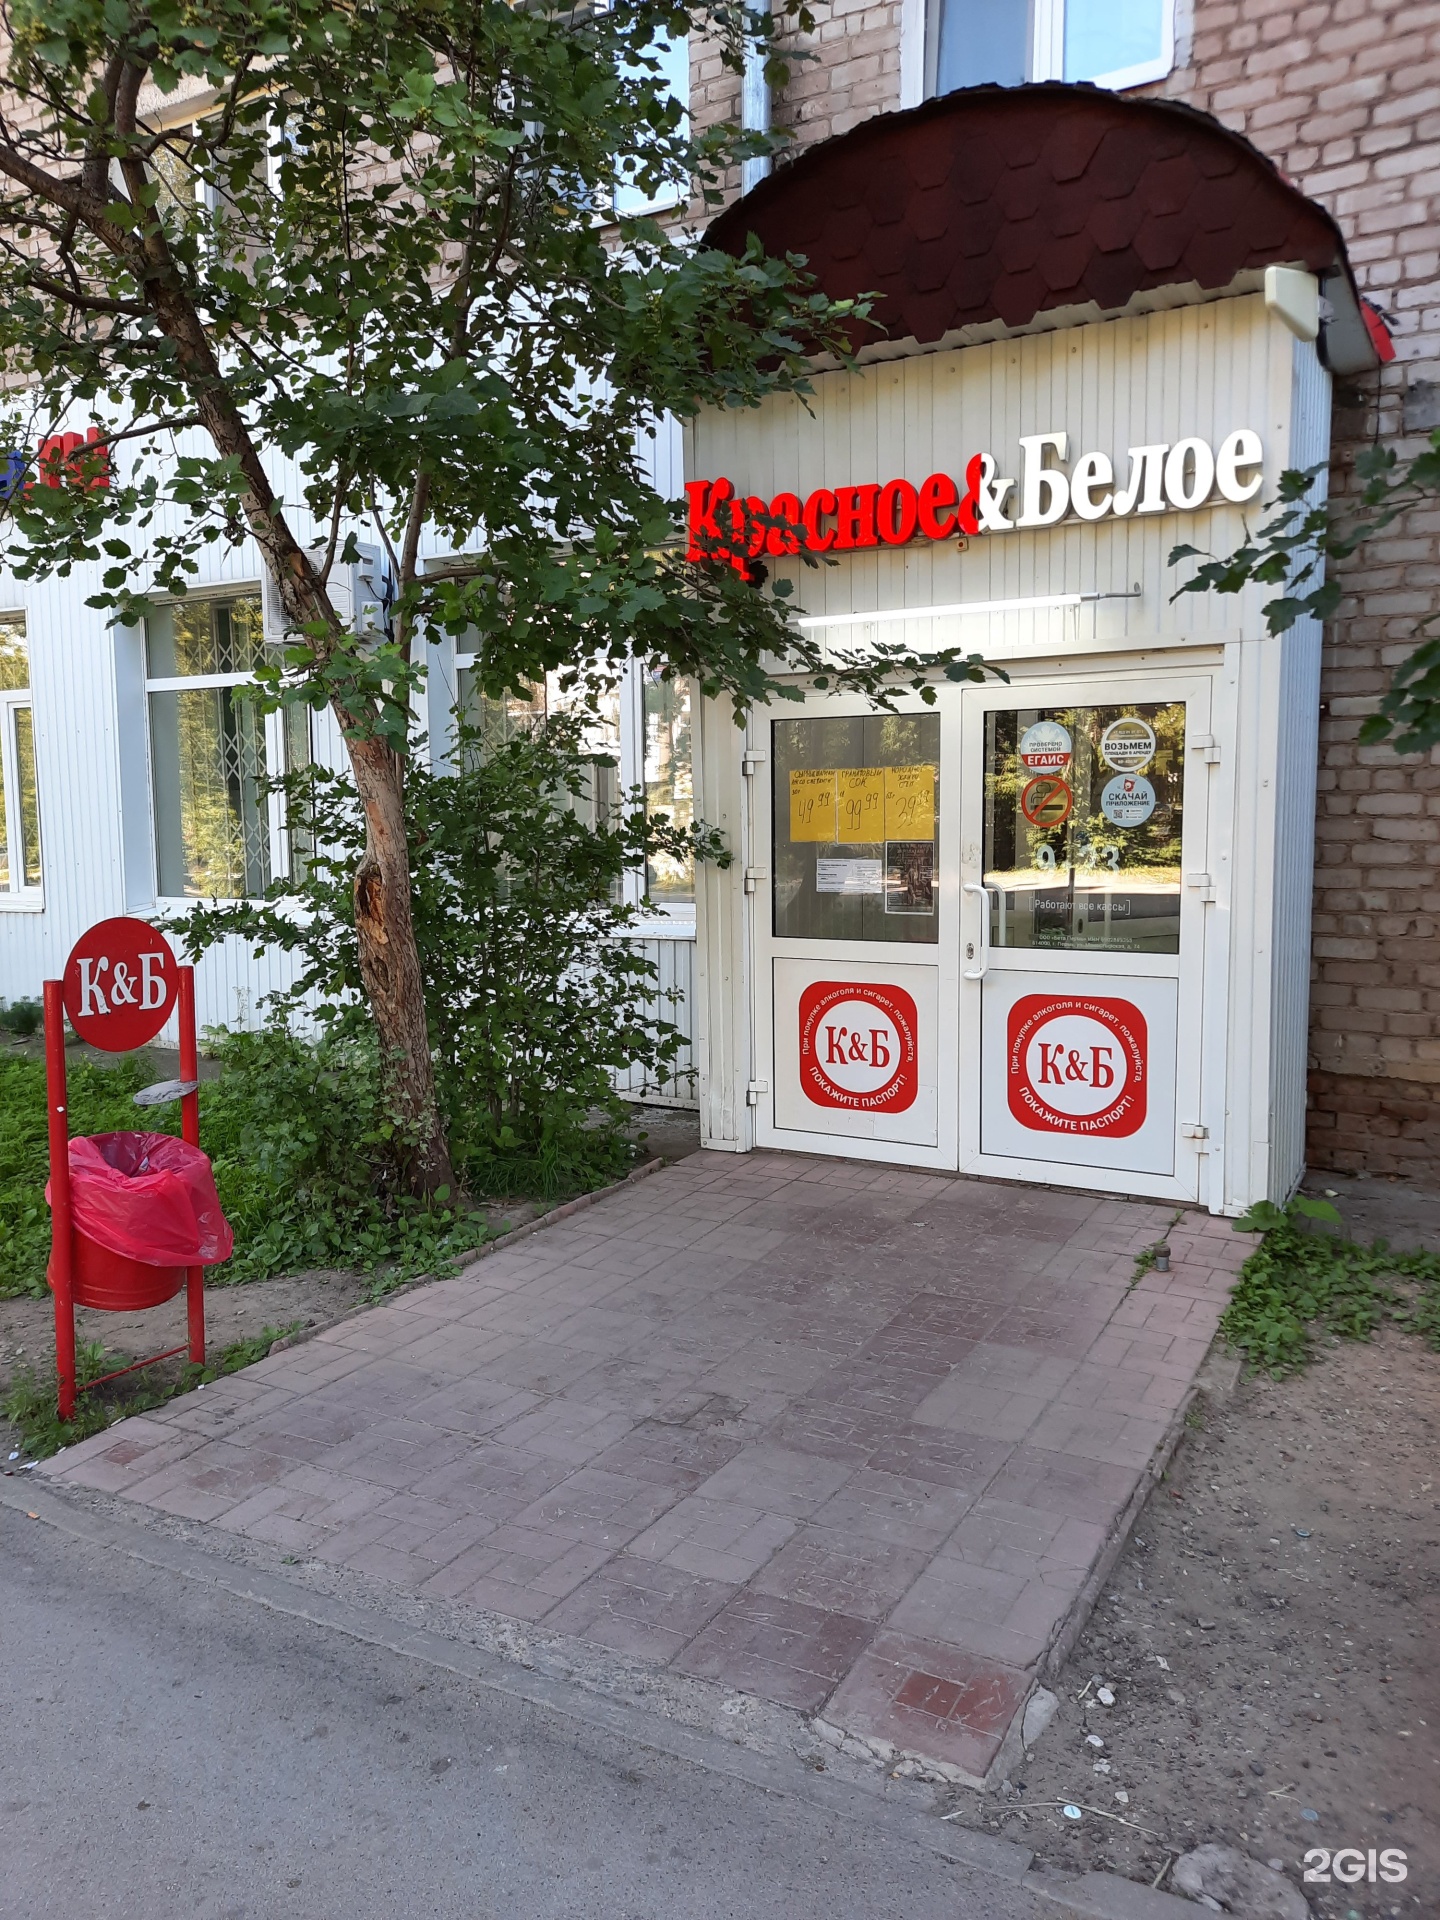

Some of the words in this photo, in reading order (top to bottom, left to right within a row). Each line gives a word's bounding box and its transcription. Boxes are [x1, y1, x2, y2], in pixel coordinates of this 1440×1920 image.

[1028, 754, 1064, 765] ЕГАИС
[1104, 742, 1152, 750] ВОЗЬМЕМ
[848, 778, 868, 788] СОК
[1108, 791, 1148, 800] СКАЧАЙ
[798, 798, 814, 824] 49
[818, 792, 830, 808] 99
[846, 799, 861, 830] 99
[864, 792, 879, 810] 99
[896, 796, 916, 829] 39
[1078, 902, 1094, 910] все
[77, 952, 167, 1017] К&Б
[804, 1004, 821, 1036] покупке
[820, 987, 854, 1006] алкоголя
[863, 989, 894, 1011] сигарет,
[894, 1009, 914, 1063] пожалуйста,
[1034, 1001, 1073, 1020] алкоголя
[1084, 1002, 1119, 1026] сигарет,
[825, 1026, 890, 1068] К&Б
[1013, 1019, 1033, 1054] покупке
[1010, 1055, 1019, 1074] При
[1038, 1043, 1114, 1088] К&Б
[1120, 1025, 1142, 1083] пожалуйста,
[809, 1066, 860, 1107] ПОКАЖИТЕ
[861, 1073, 908, 1107] ПАСПОРТ!
[1019, 1086, 1077, 1130] ПОКАЖИТЕ
[1080, 1095, 1134, 1131] ПАСПОРТ!
